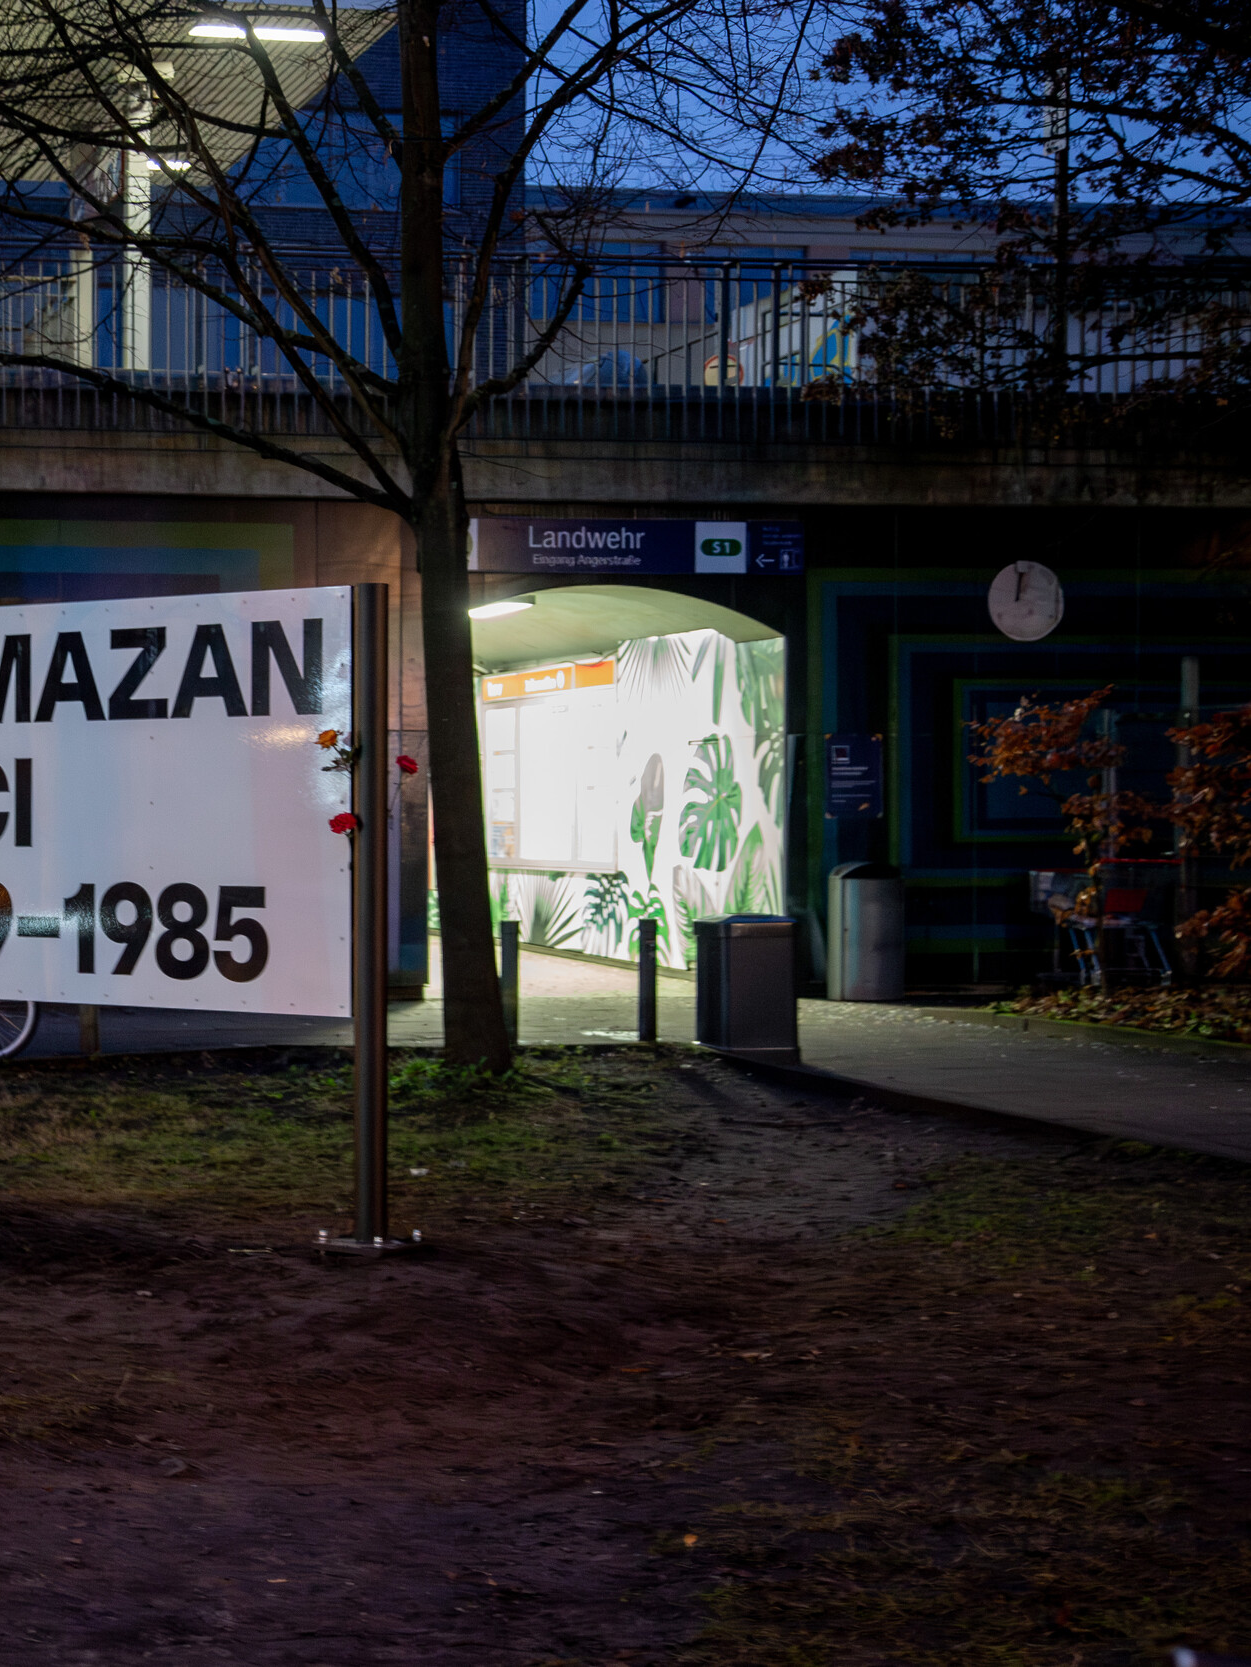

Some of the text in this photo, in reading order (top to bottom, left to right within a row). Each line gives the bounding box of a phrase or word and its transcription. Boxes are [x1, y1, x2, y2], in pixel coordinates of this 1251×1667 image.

[528, 525, 646, 550] Landwehr
[532, 554, 642, 567] Eingang Angerstraße
